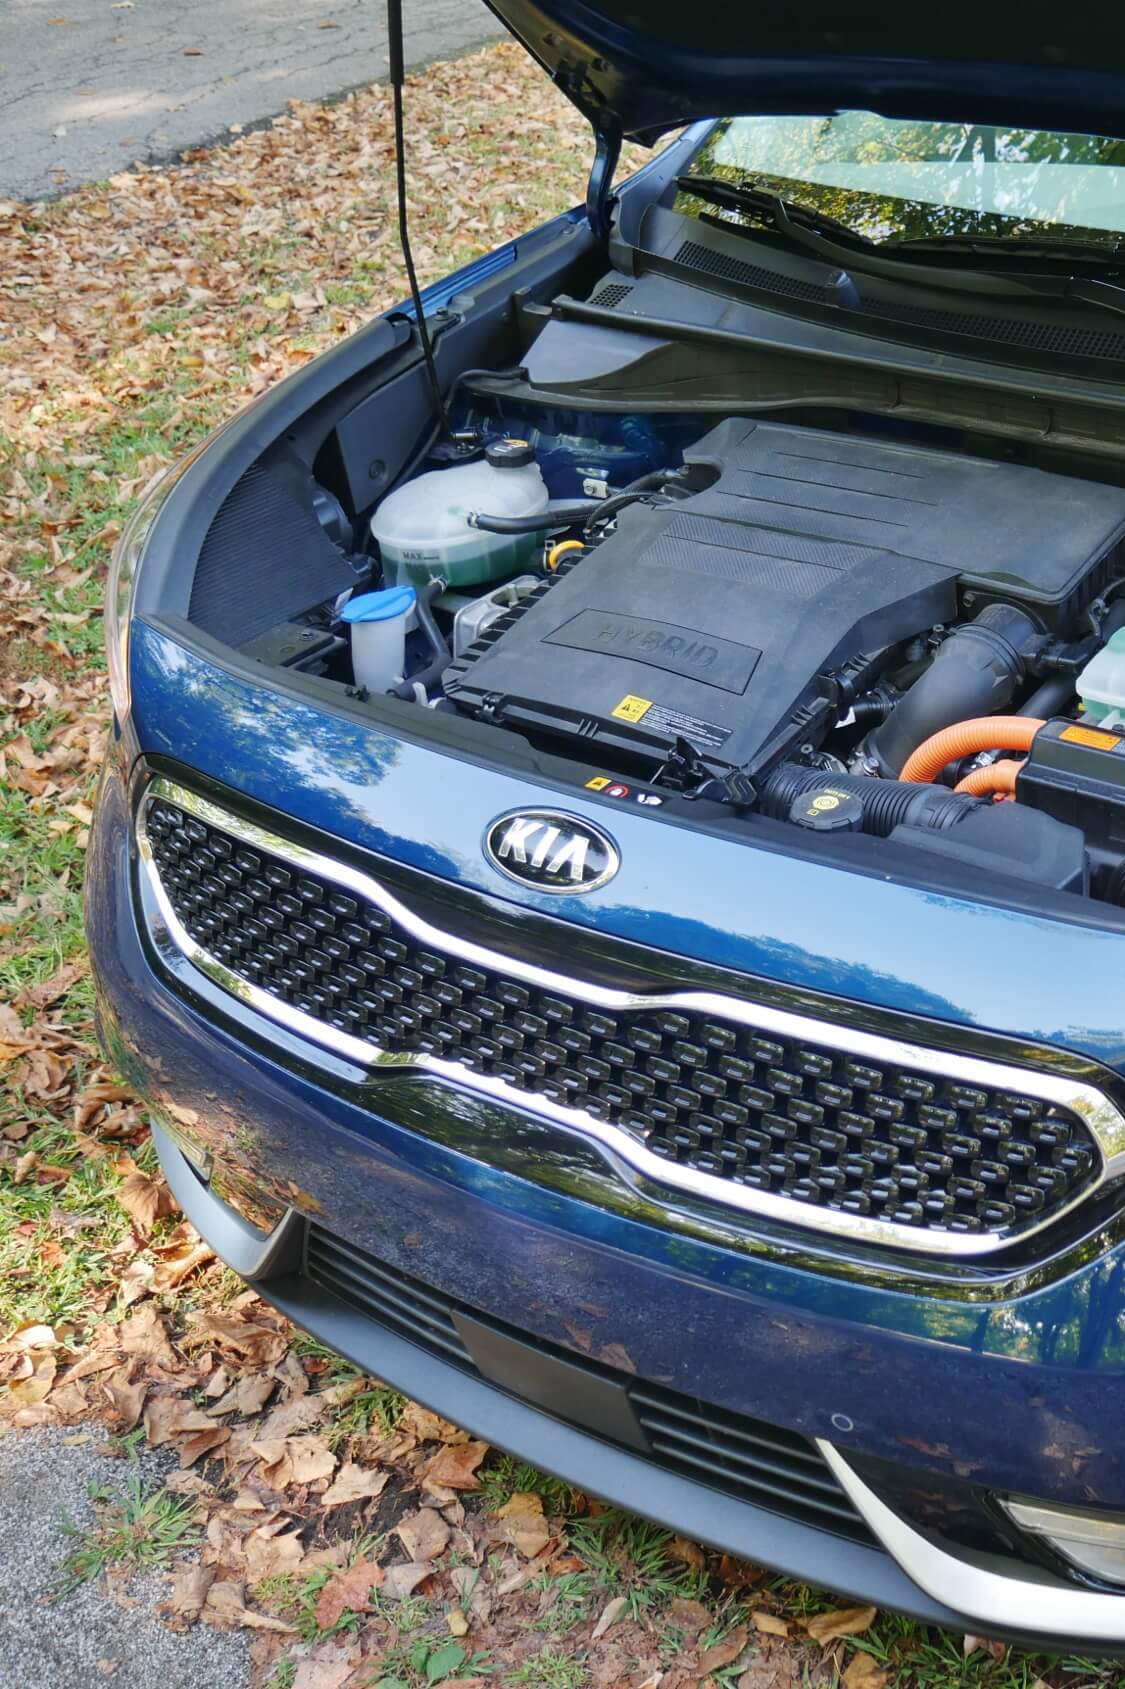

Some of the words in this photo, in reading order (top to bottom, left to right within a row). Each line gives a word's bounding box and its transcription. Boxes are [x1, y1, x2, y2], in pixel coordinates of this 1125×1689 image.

[402, 551, 422, 560] MAX
[597, 621, 719, 669] HYBRID
[498, 818, 590, 881] KIA
